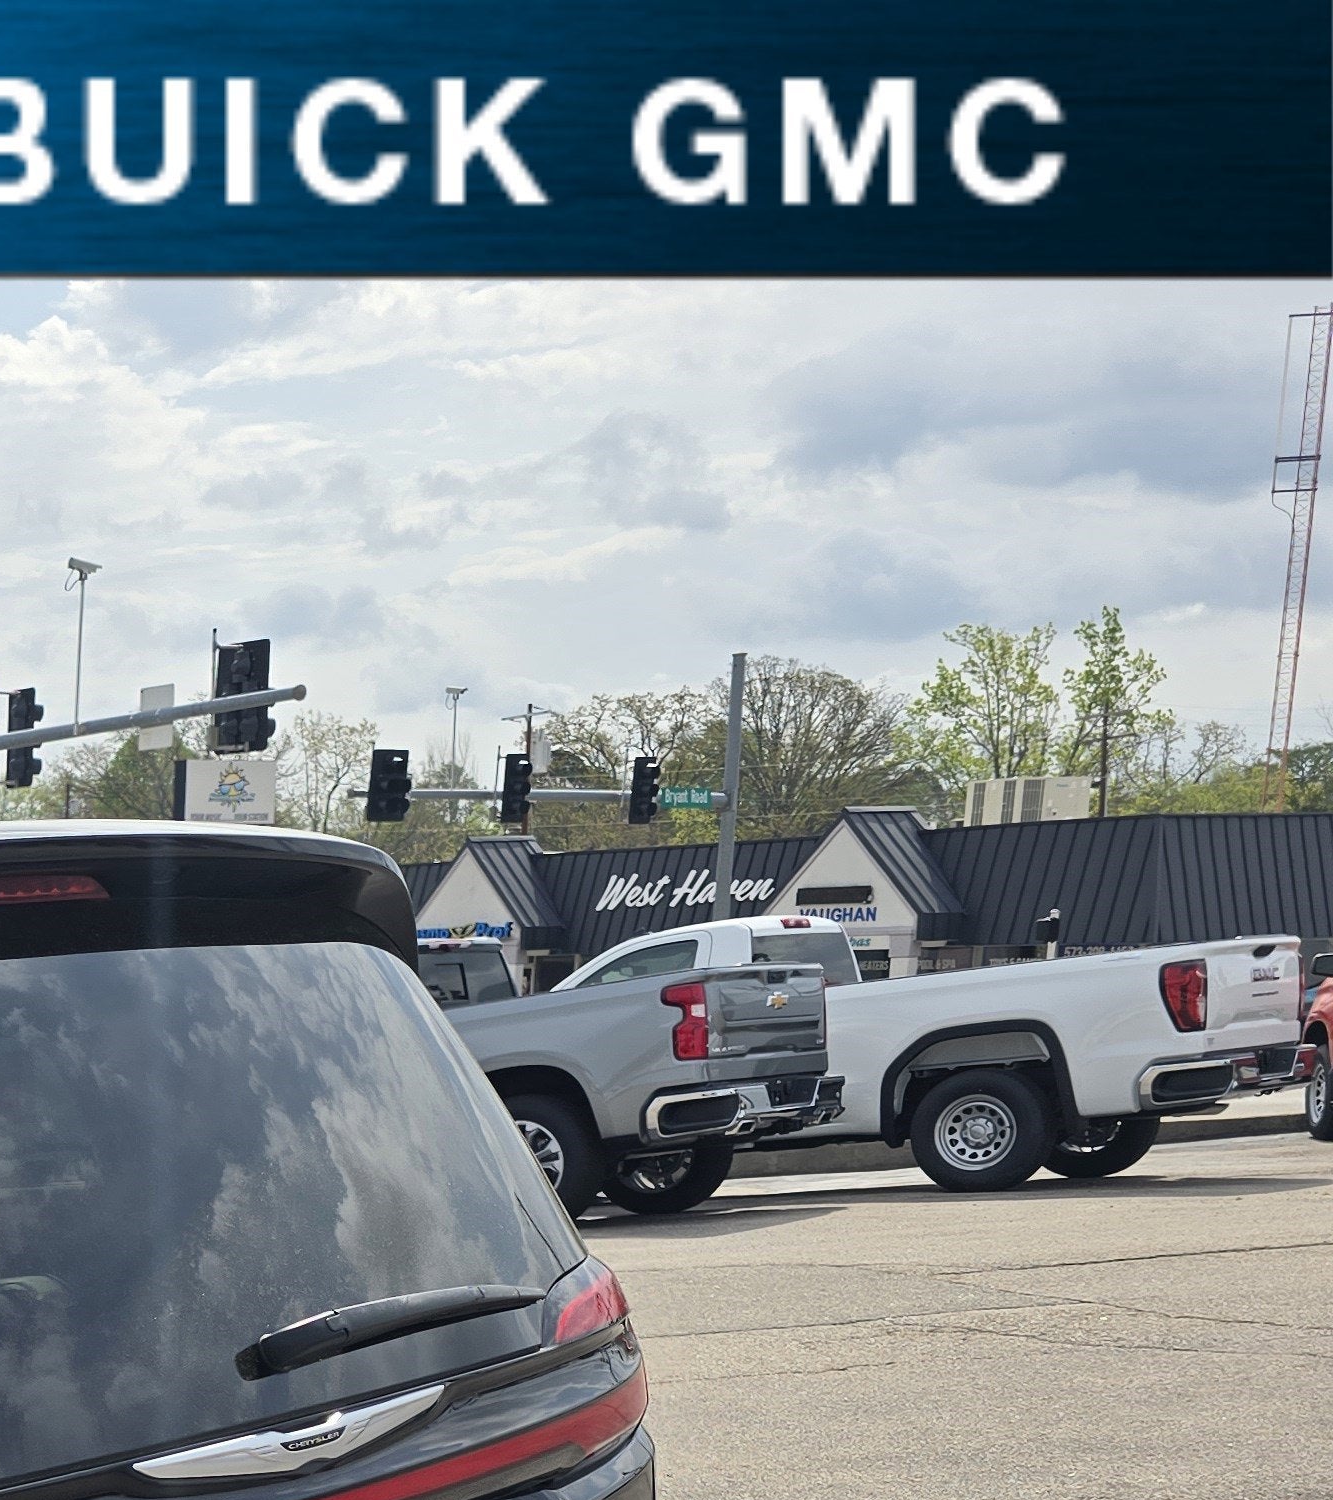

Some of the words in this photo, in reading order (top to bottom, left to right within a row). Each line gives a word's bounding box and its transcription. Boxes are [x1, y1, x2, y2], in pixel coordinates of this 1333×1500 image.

[664, 788, 689, 807] Bryant
[690, 788, 708, 804] Road
[595, 873, 672, 912] West
[800, 907, 877, 922] VAUGHAN
[474, 921, 513, 939] Prof
[288, 1431, 340, 1450] CHRYSLER
